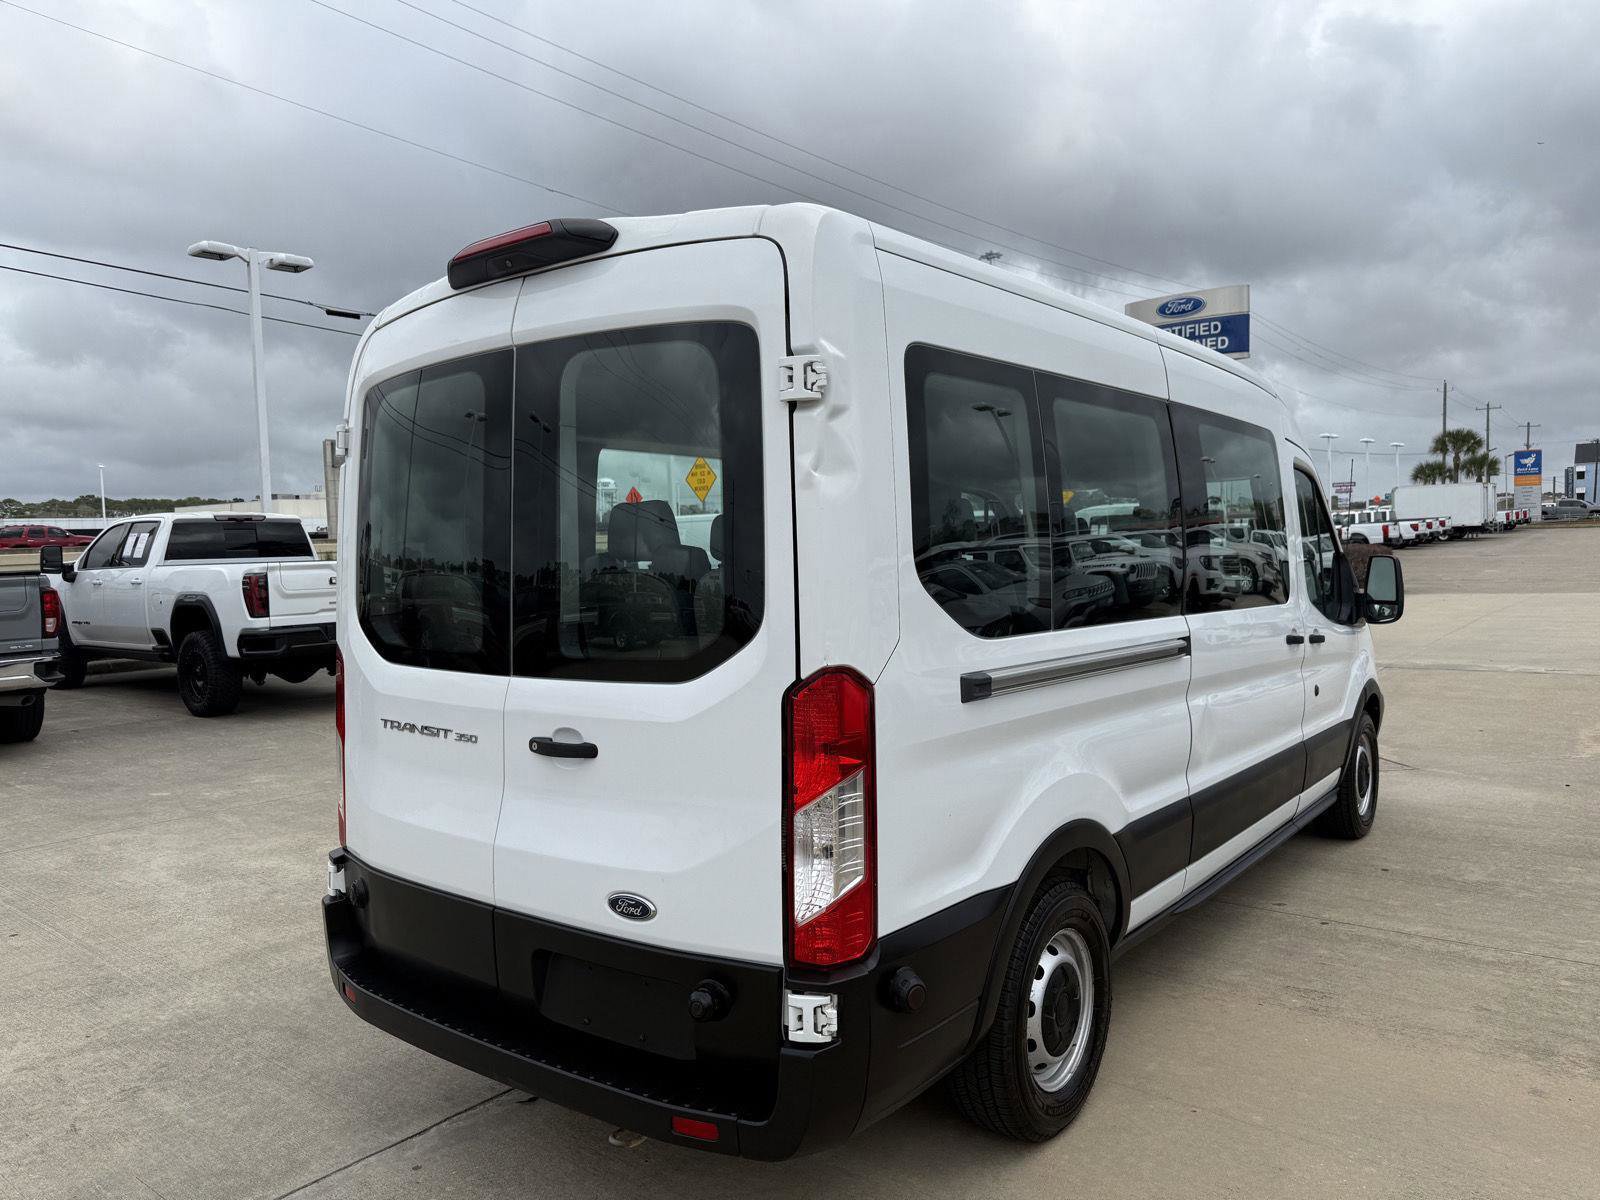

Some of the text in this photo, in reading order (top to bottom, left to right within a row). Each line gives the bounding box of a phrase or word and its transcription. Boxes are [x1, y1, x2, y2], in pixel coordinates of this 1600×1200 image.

[1165, 299, 1194, 314] Ford
[1164, 321, 1222, 338] TIFIED
[380, 718, 479, 744] TRANSIT 350
[615, 898, 643, 916] Ford
